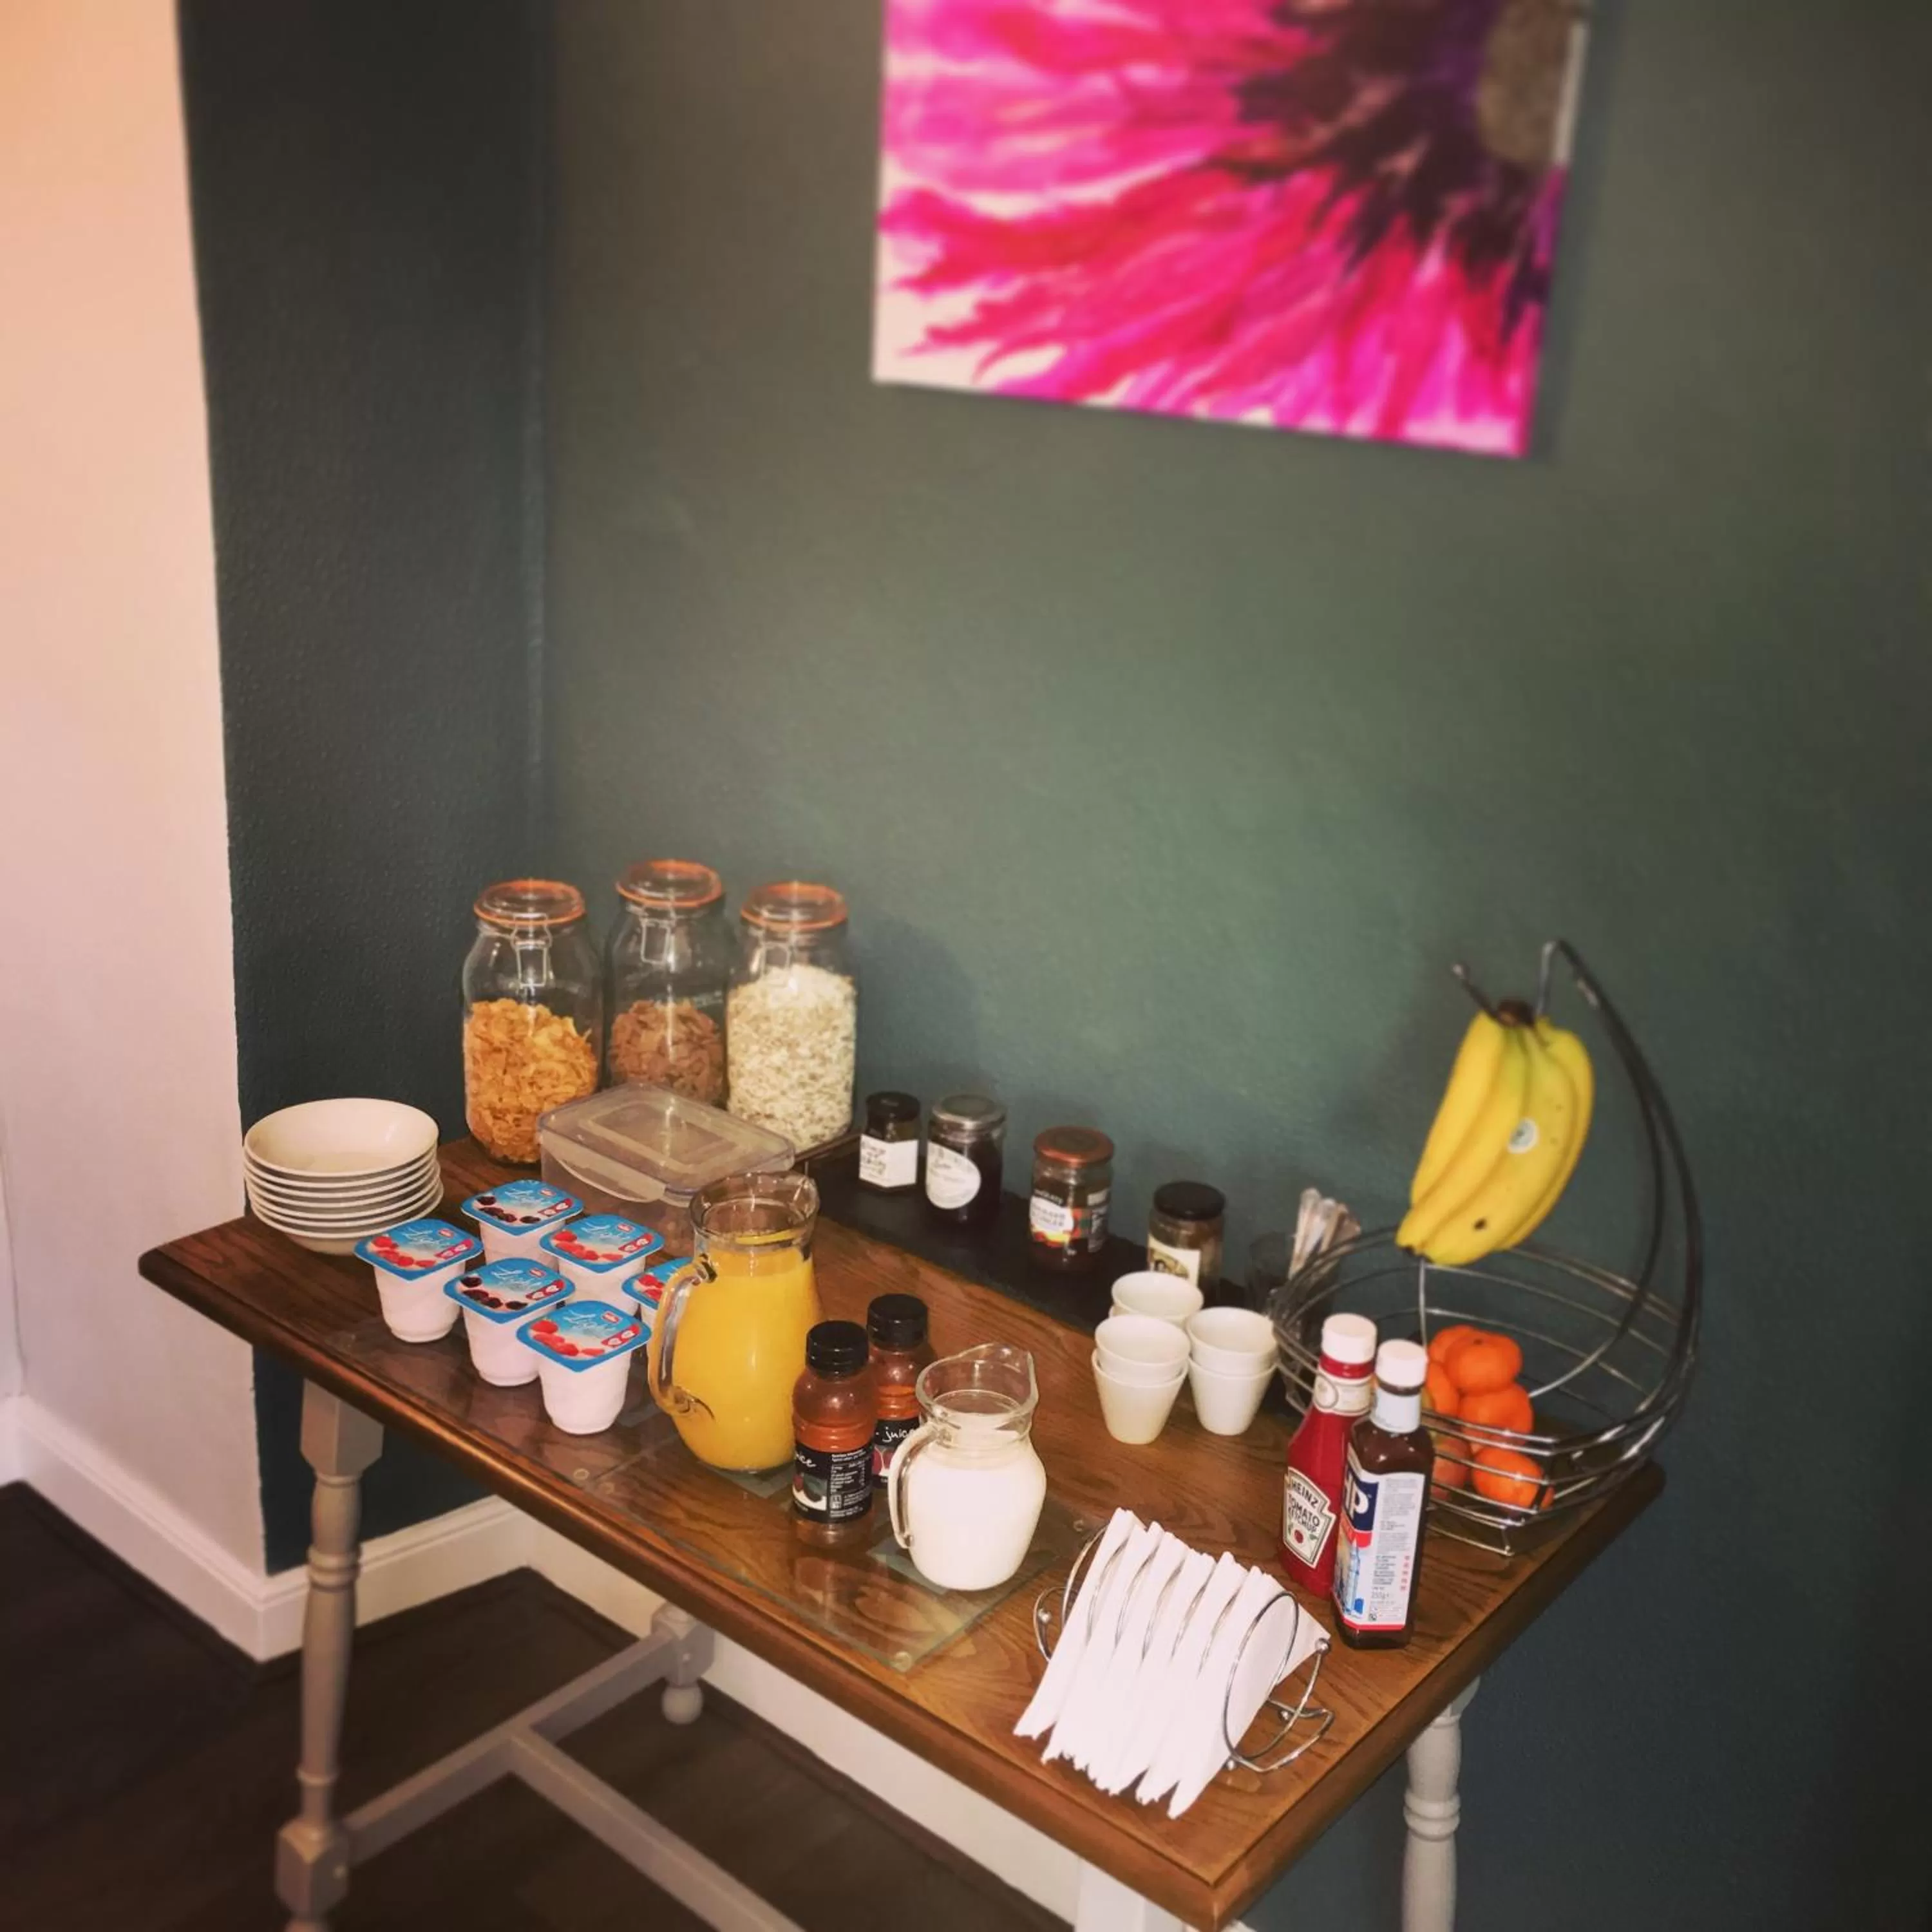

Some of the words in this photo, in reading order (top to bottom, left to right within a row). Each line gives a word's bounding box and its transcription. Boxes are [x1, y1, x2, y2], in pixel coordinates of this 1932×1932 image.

[1291, 1479, 1319, 1508] HEINZ
[1288, 1492, 1320, 1527] TOMATO
[1288, 1506, 1318, 1533] KETCHUP
